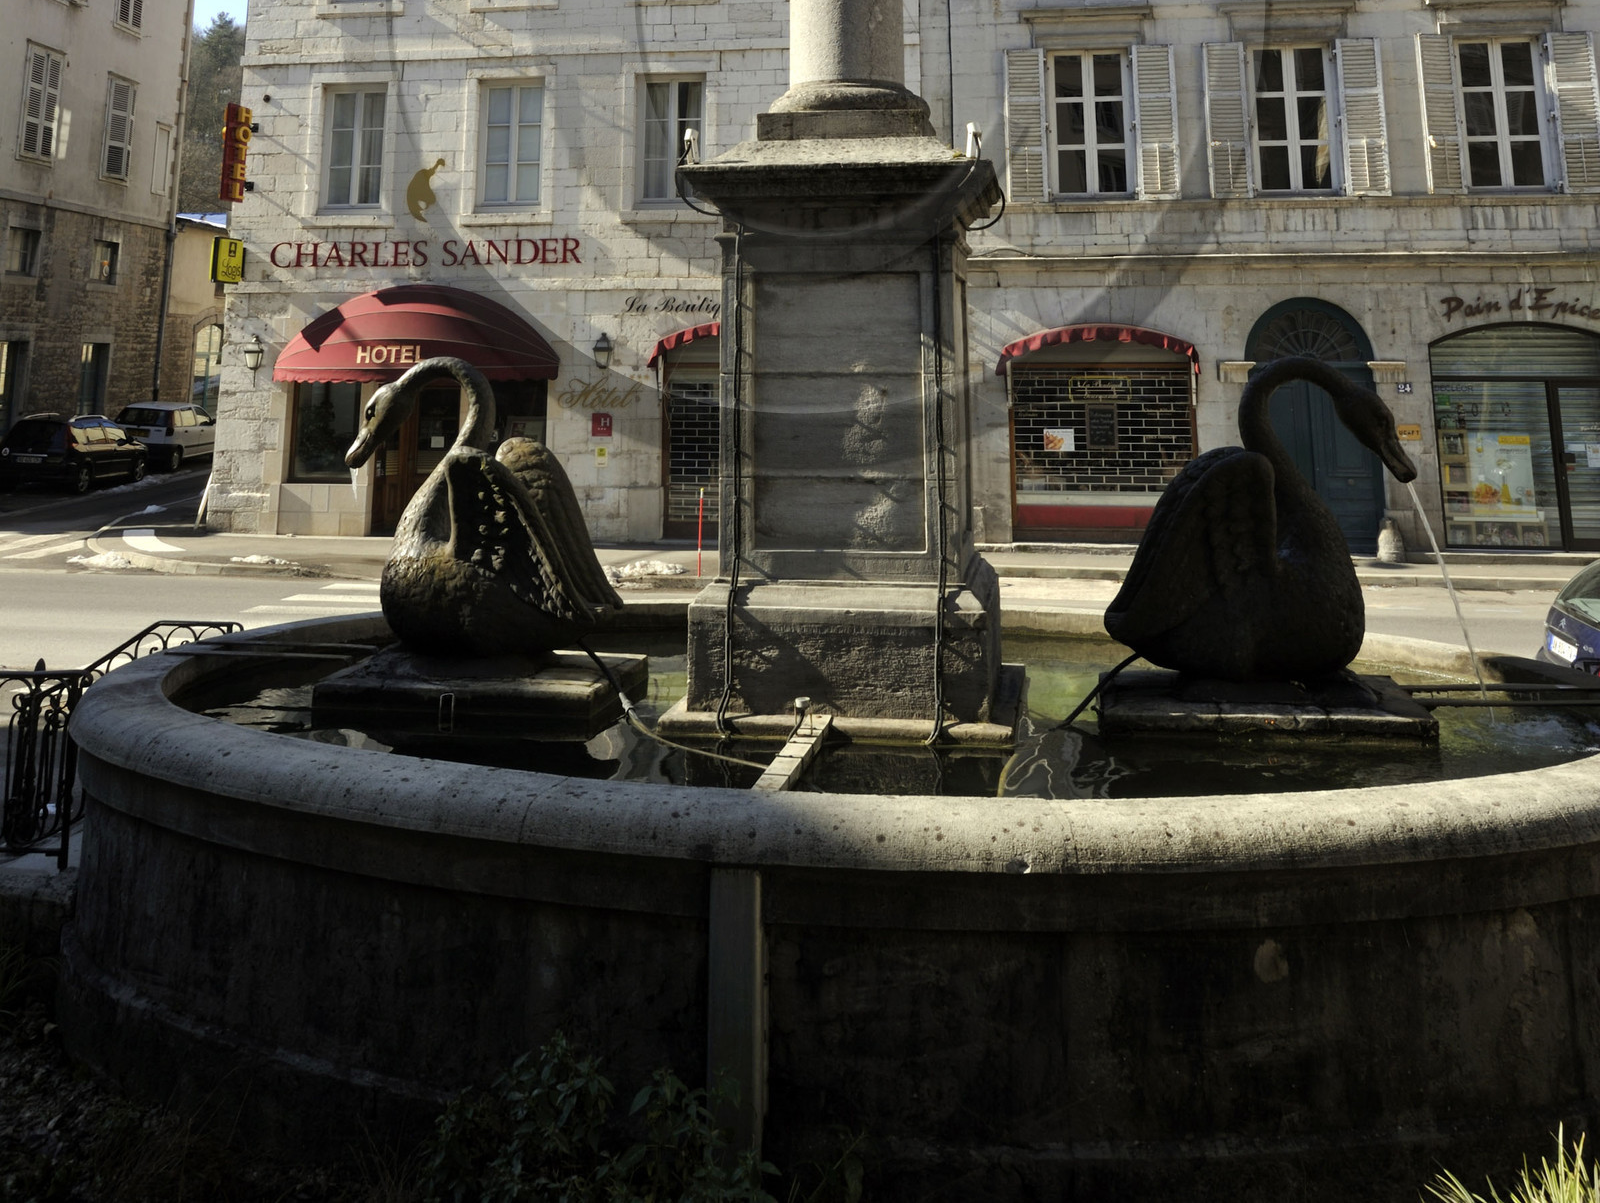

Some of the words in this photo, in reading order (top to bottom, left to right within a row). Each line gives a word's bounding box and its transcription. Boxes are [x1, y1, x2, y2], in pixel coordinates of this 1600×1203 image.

[232, 107, 252, 200] HOTEL
[270, 240, 428, 268] CHARLES
[442, 238, 582, 265] SANDER
[625, 296, 648, 313] La
[1440, 296, 1502, 322] Pain
[356, 345, 425, 364] HOTEL
[1398, 383, 1411, 393] 24
[601, 417, 610, 427] H
